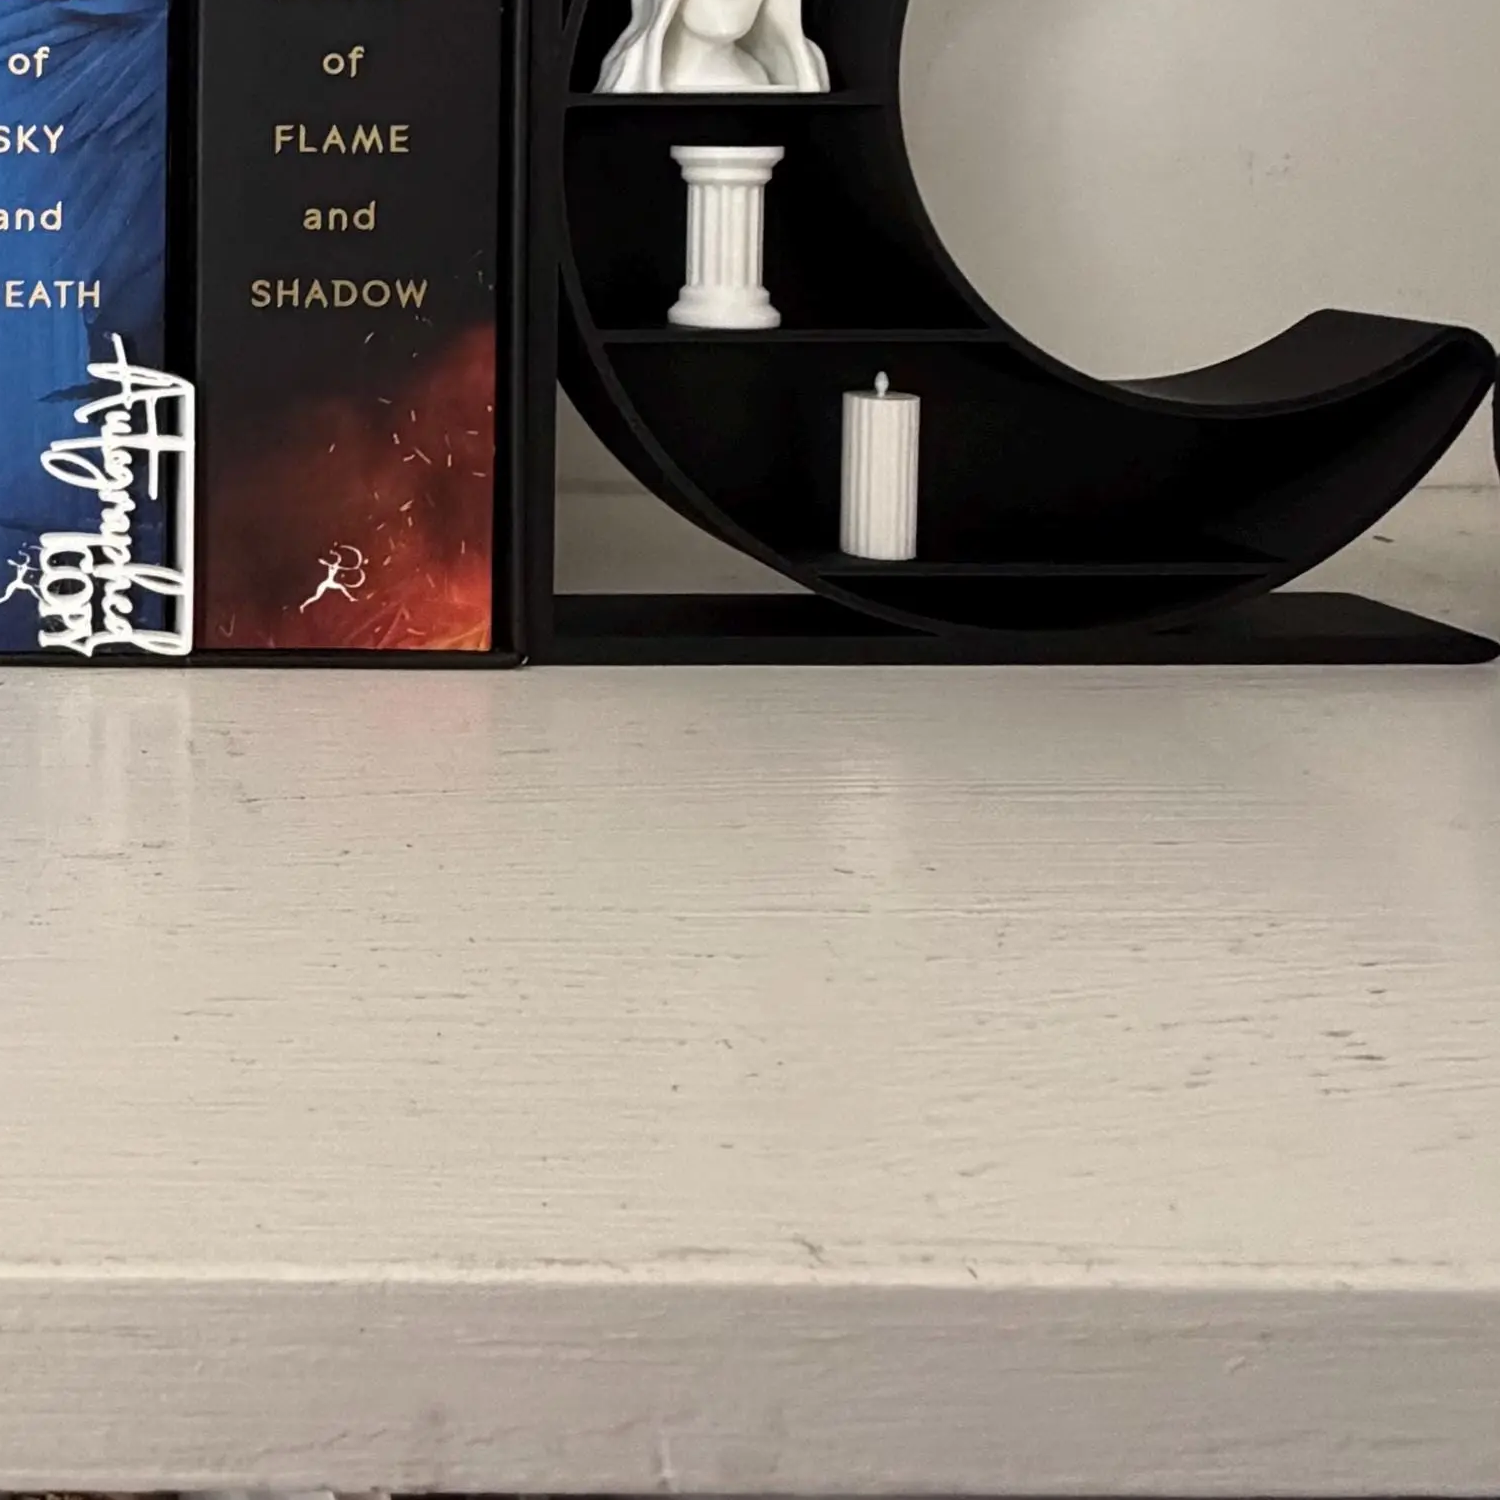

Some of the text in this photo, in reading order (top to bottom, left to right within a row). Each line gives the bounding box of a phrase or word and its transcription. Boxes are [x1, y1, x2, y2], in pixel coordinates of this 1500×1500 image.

[7, 46, 51, 78] of
[322, 46, 365, 78] of
[274, 124, 410, 155] FLAME
[302, 200, 376, 231] and
[250, 278, 428, 309] SHADOW
[40, 332, 195, 656] Autographed
[37, 544, 94, 657] COPY
